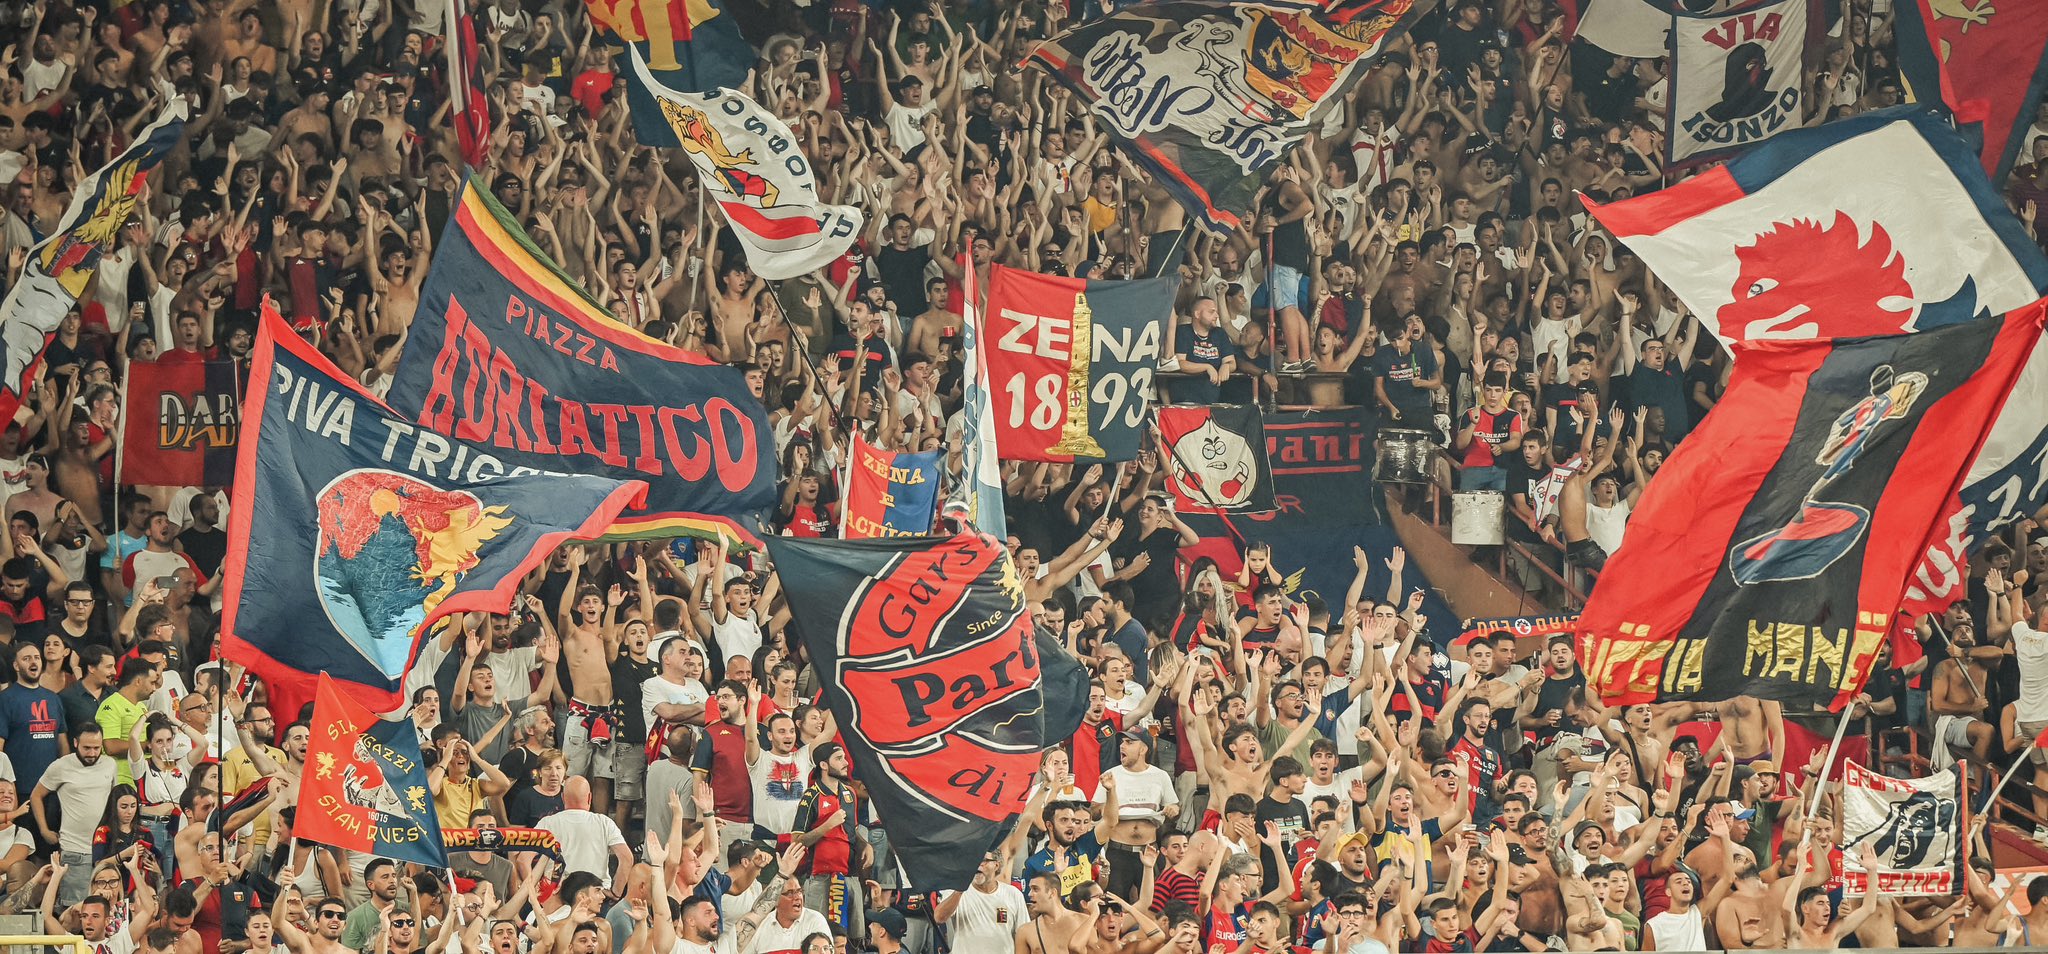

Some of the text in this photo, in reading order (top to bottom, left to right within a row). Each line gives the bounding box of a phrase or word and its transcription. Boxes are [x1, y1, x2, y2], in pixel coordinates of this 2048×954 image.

[1702, 13, 1783, 50] VIA
[1681, 87, 1799, 143] ISONZO
[506, 294, 620, 374] PIAZZA
[416, 292, 757, 493] ADRIATICO
[863, 452, 926, 485] ZÊNA
[879, 490, 895, 508] E
[966, 609, 1003, 635] Since
[947, 764, 1001, 806] di
[1472, 785, 1488, 797] MSC
[317, 794, 362, 836] SIAM
[367, 810, 389, 823] 16015
[442, 830, 476, 848] NCE
